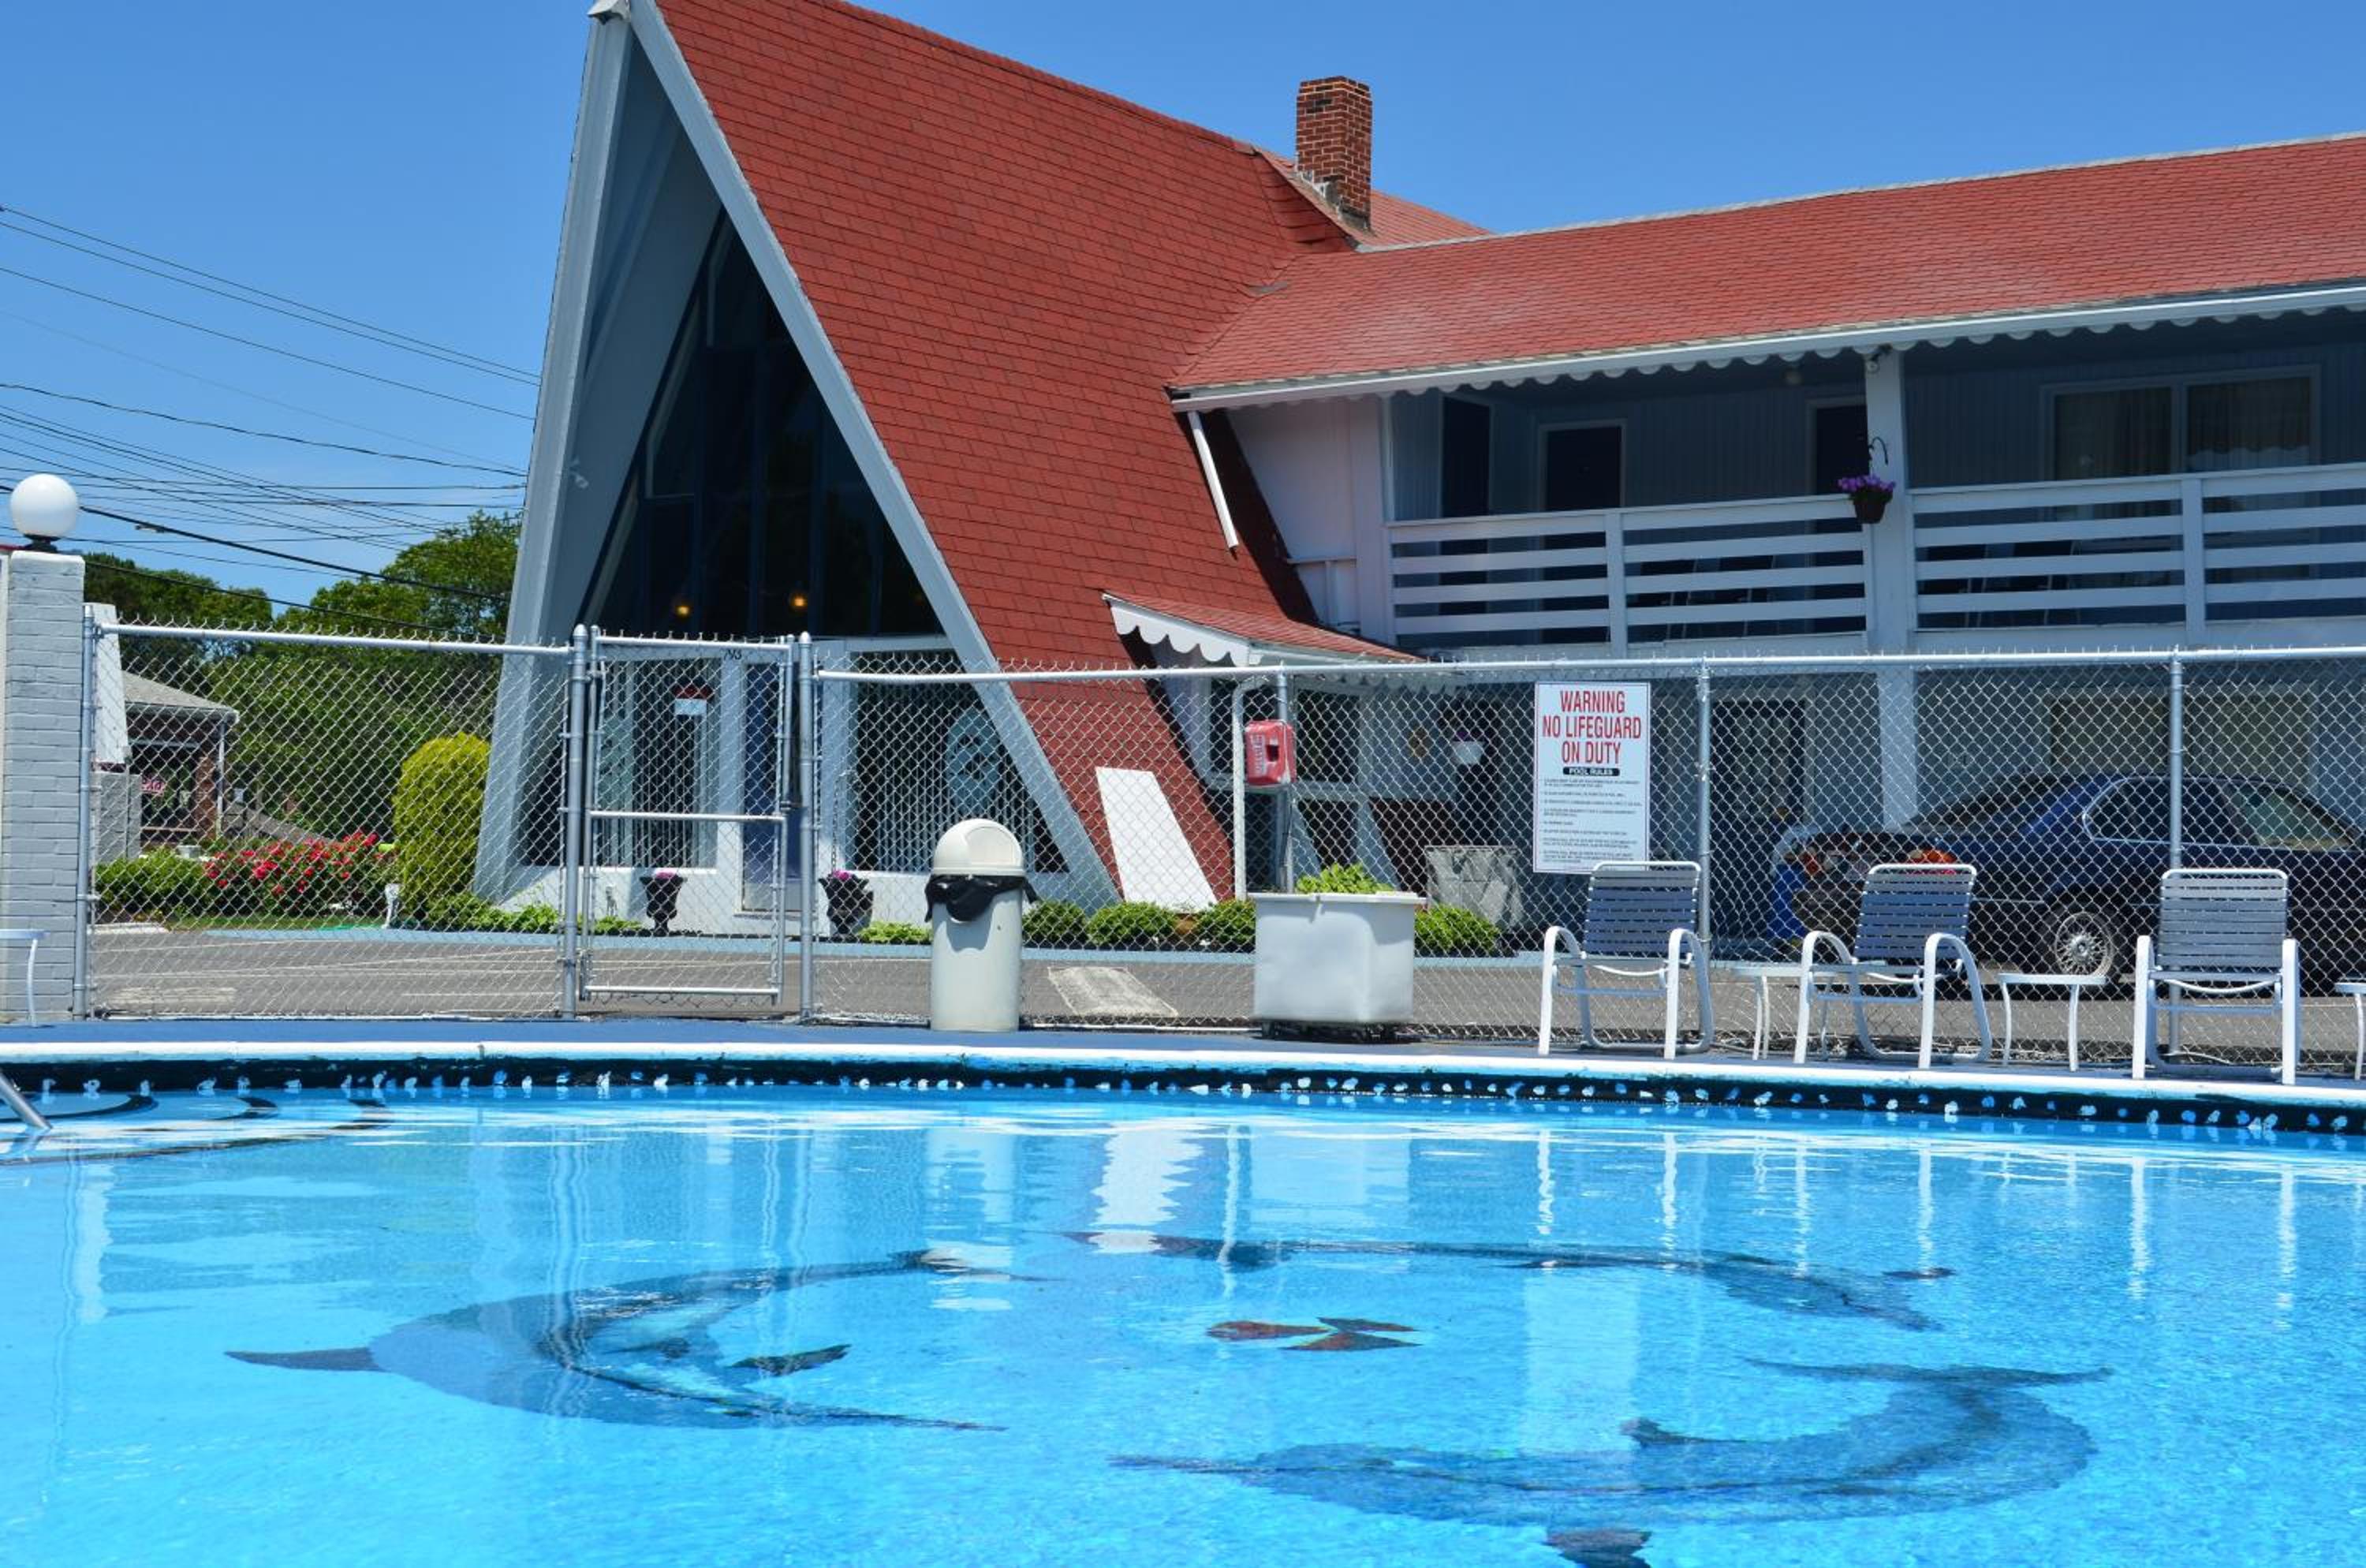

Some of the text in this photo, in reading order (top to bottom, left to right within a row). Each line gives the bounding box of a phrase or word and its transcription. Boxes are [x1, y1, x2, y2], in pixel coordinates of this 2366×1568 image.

[1561, 690, 1625, 714] WARNING
[1543, 715, 1641, 739] NO LIFEGUARD
[1562, 741, 1621, 764] ON DUTY
